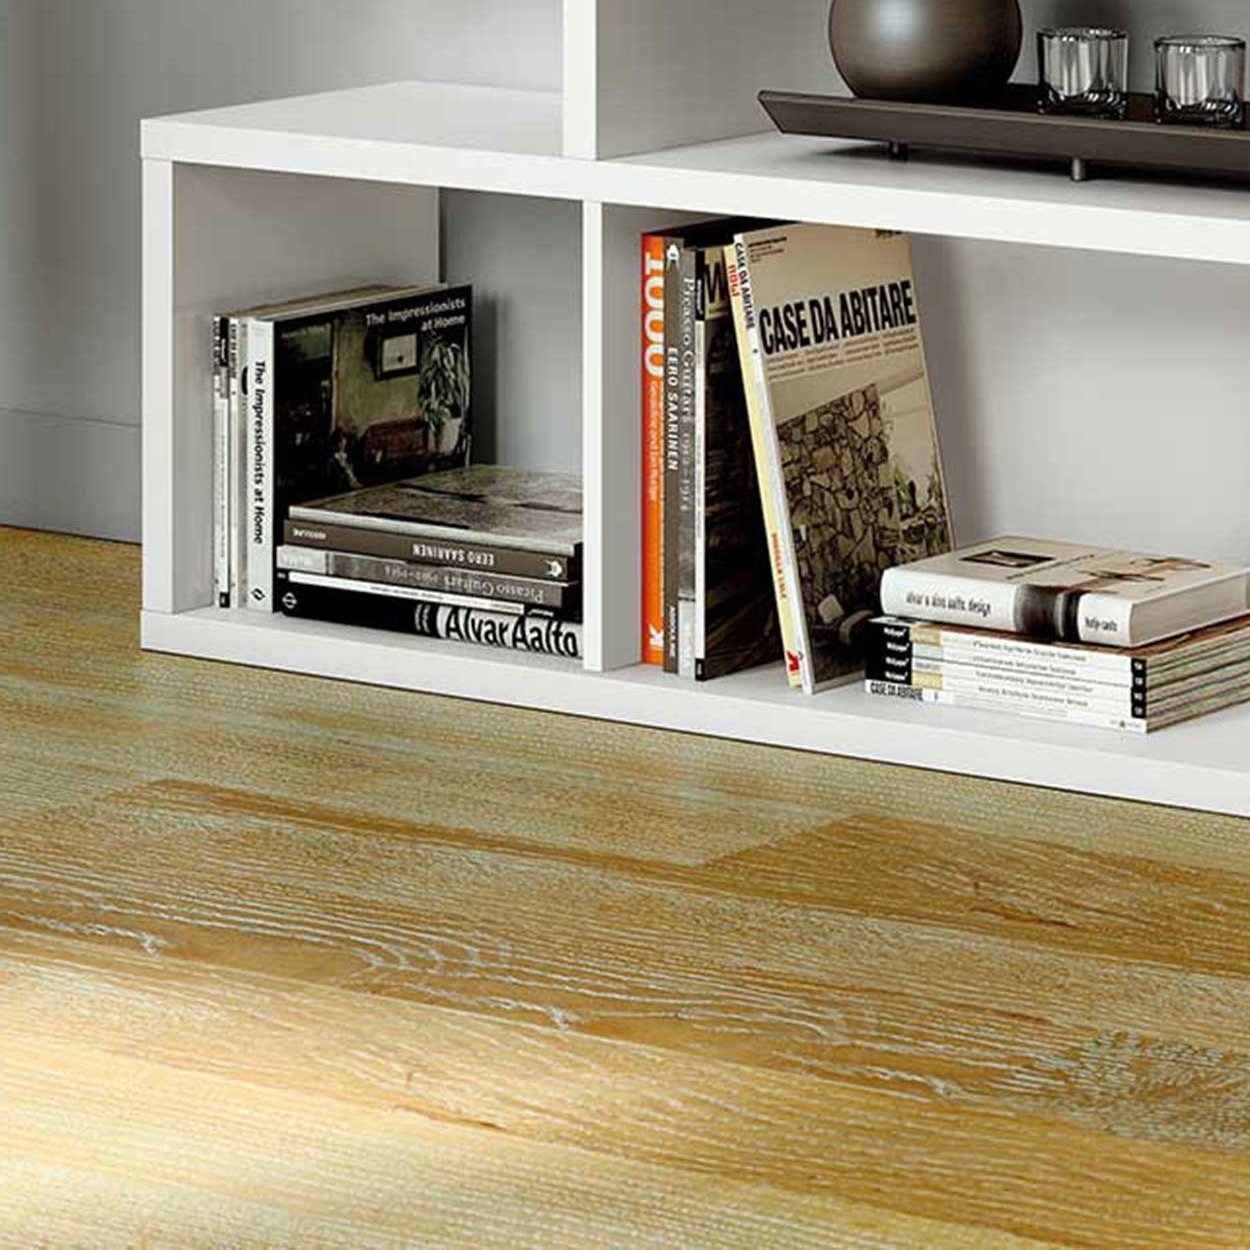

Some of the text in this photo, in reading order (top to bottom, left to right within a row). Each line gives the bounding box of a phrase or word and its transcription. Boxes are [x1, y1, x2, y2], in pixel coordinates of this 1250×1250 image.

[366, 297, 466, 326] The Impressionists
[421, 315, 465, 331] at Home
[682, 277, 694, 345] Picasso
[758, 302, 811, 356] CASE
[809, 296, 839, 345] DA
[839, 279, 917, 338] ABITARE
[666, 347, 679, 470] EERO SAARINEN
[681, 349, 695, 423] Guitars
[252, 360, 266, 544] The Impressionists at Home
[412, 543, 494, 566] EERO SAARINEN
[443, 575, 495, 598] Guitars
[497, 582, 545, 603] Picasso
[445, 605, 508, 649] Alvar
[512, 615, 579, 657] Aalto
